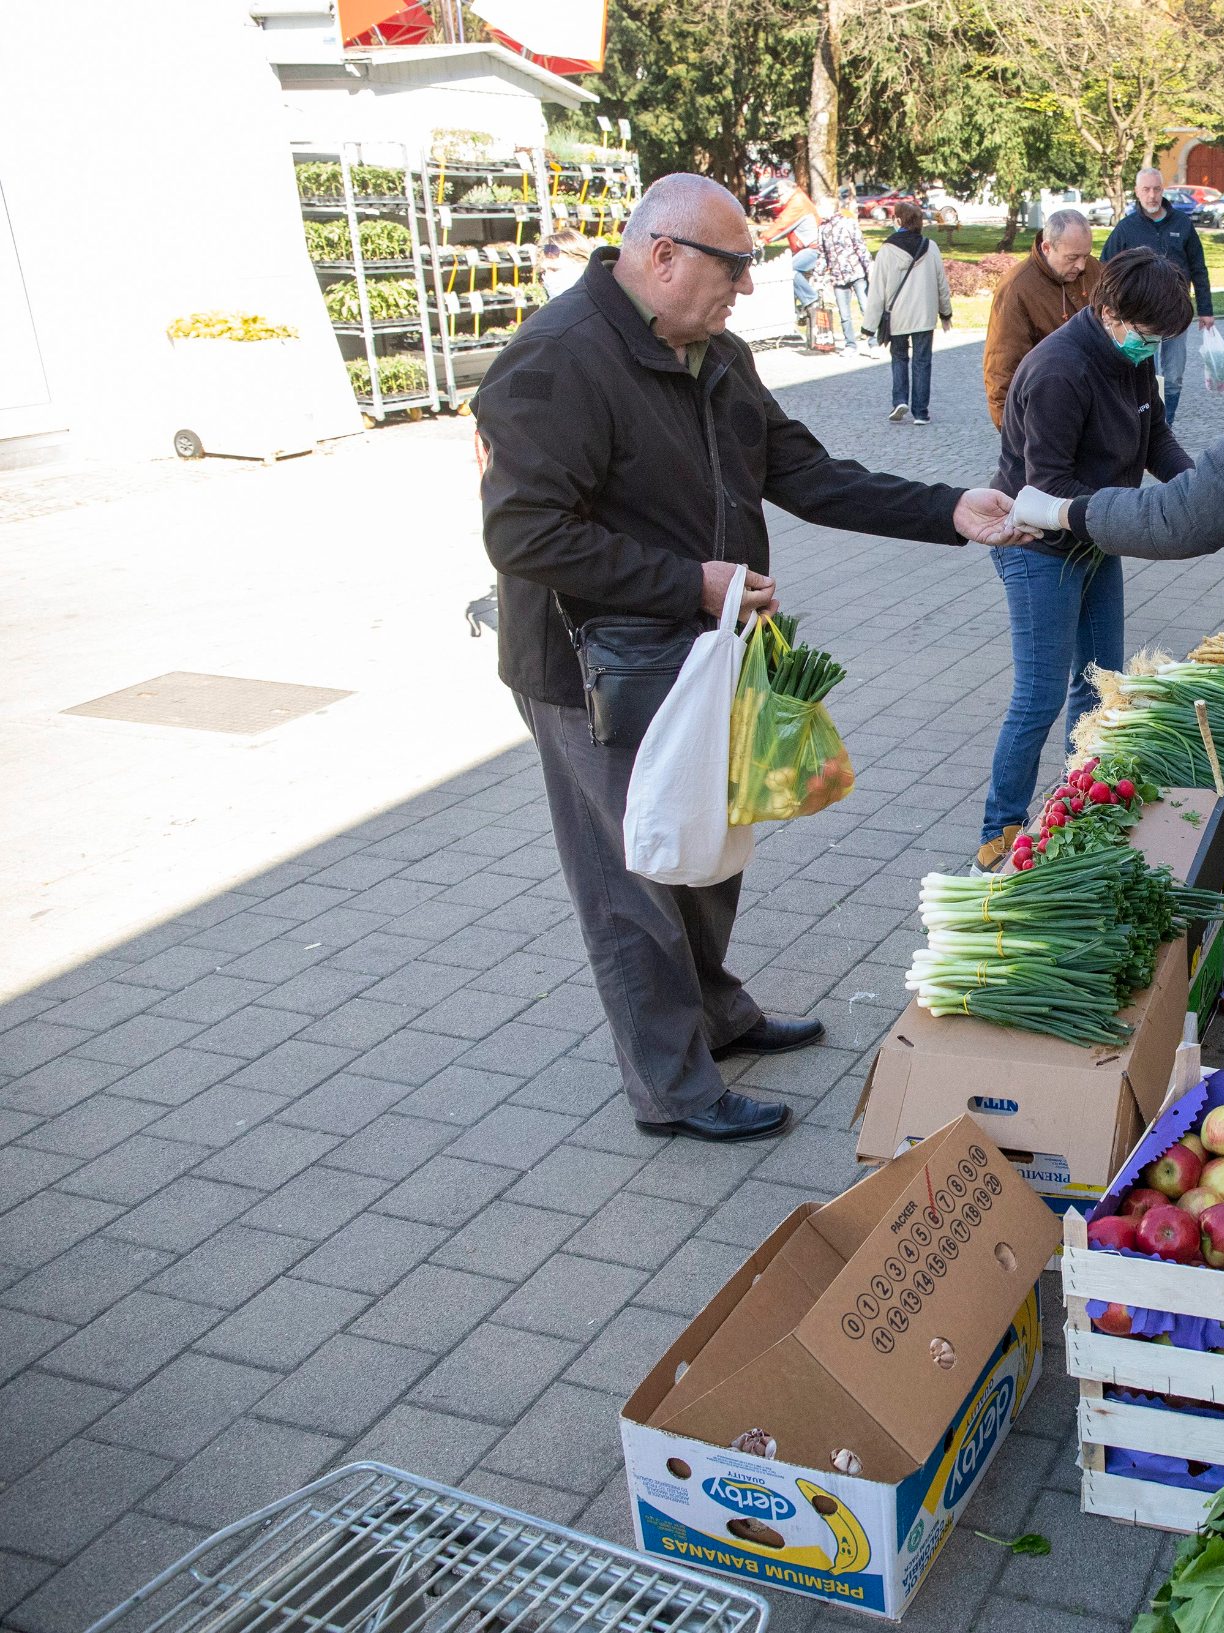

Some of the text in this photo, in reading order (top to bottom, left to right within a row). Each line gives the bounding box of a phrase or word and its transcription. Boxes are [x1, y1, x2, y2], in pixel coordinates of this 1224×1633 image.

[848, 1148, 985, 1332] 0 1 2 3 4 5 6 7 8 9 10
[890, 1200, 918, 1235] PACKER
[876, 1176, 1000, 1348] 11 12 13 14 15 16 17 18 19 20
[949, 1383, 1009, 1499] derby
[710, 1477, 788, 1520] derby
[728, 1470, 766, 1484] QUALITY
[662, 1536, 865, 1599] PREMIUM BANANAS
[902, 1519, 945, 1587] COLOMBIA
[920, 1511, 955, 1573] PRODUCE
[905, 1574, 918, 1598] OF
